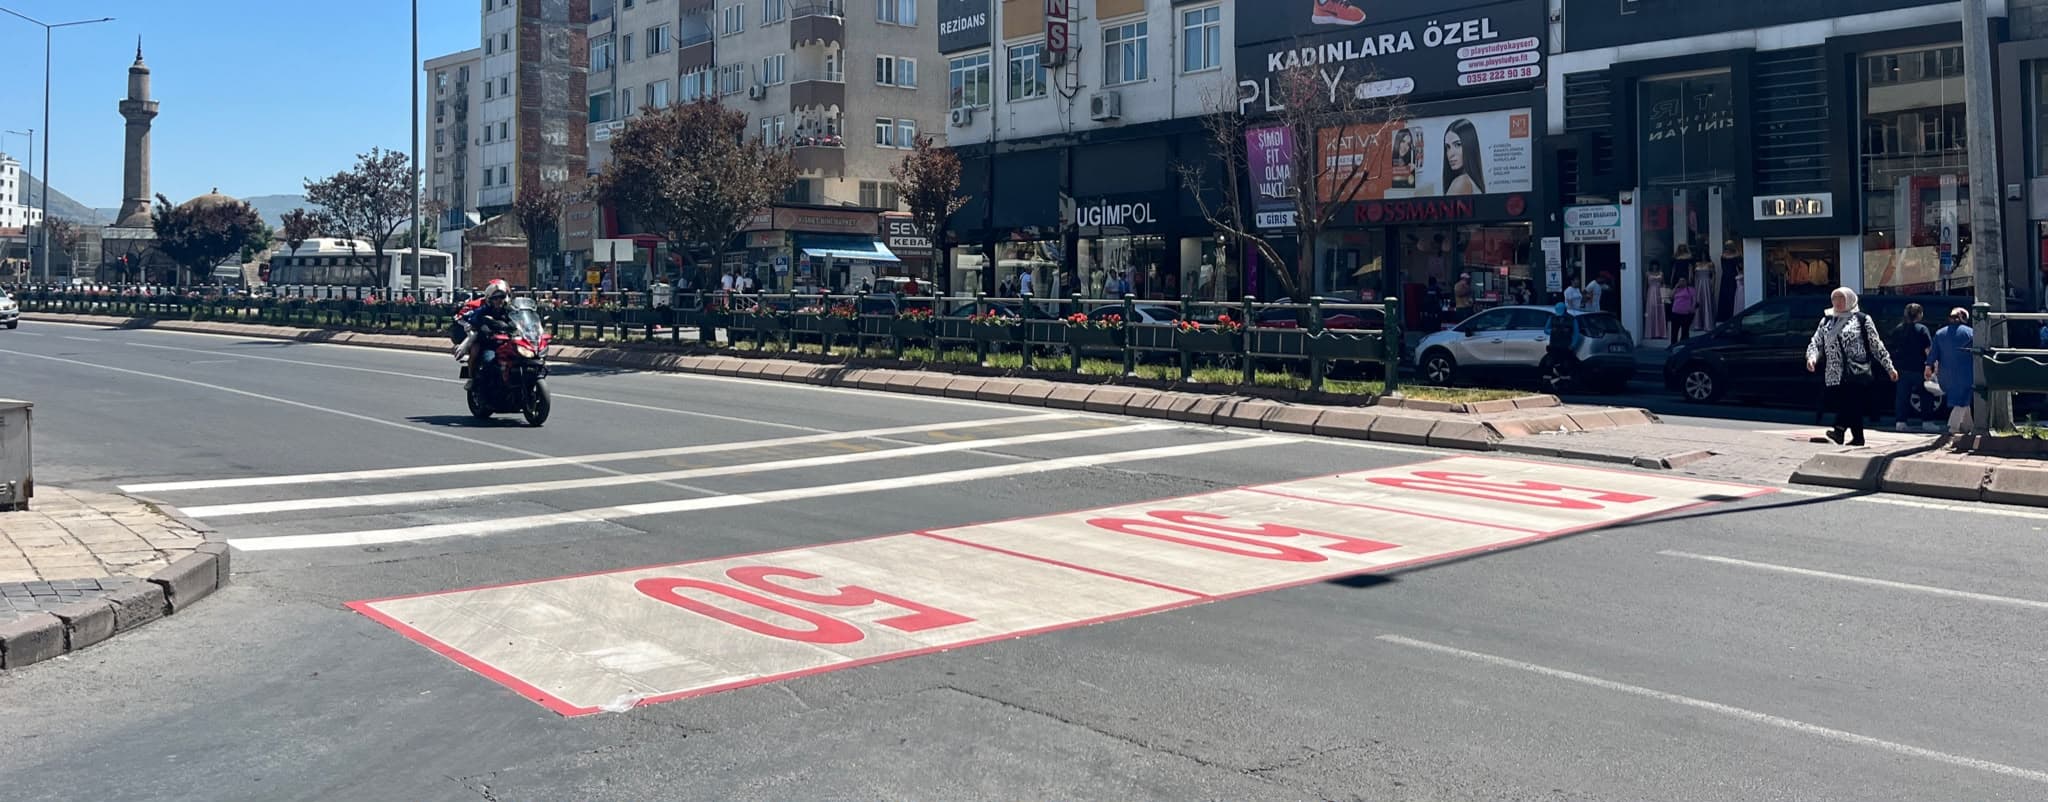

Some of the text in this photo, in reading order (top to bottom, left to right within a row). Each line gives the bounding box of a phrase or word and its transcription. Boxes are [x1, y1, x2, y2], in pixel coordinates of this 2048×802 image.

[940, 12, 986, 36] REZİDANS
[1267, 17, 1498, 72] KADINLARA ÖZEL
[1239, 66, 1344, 115] PLY
[1467, 67, 1531, 83] 0352 222 90 38
[1265, 164, 1290, 181] OLMA
[1355, 199, 1473, 223] ROSSMANN
[1365, 471, 1656, 509] 50
[1086, 510, 1401, 563] 50
[634, 566, 977, 643] 50
